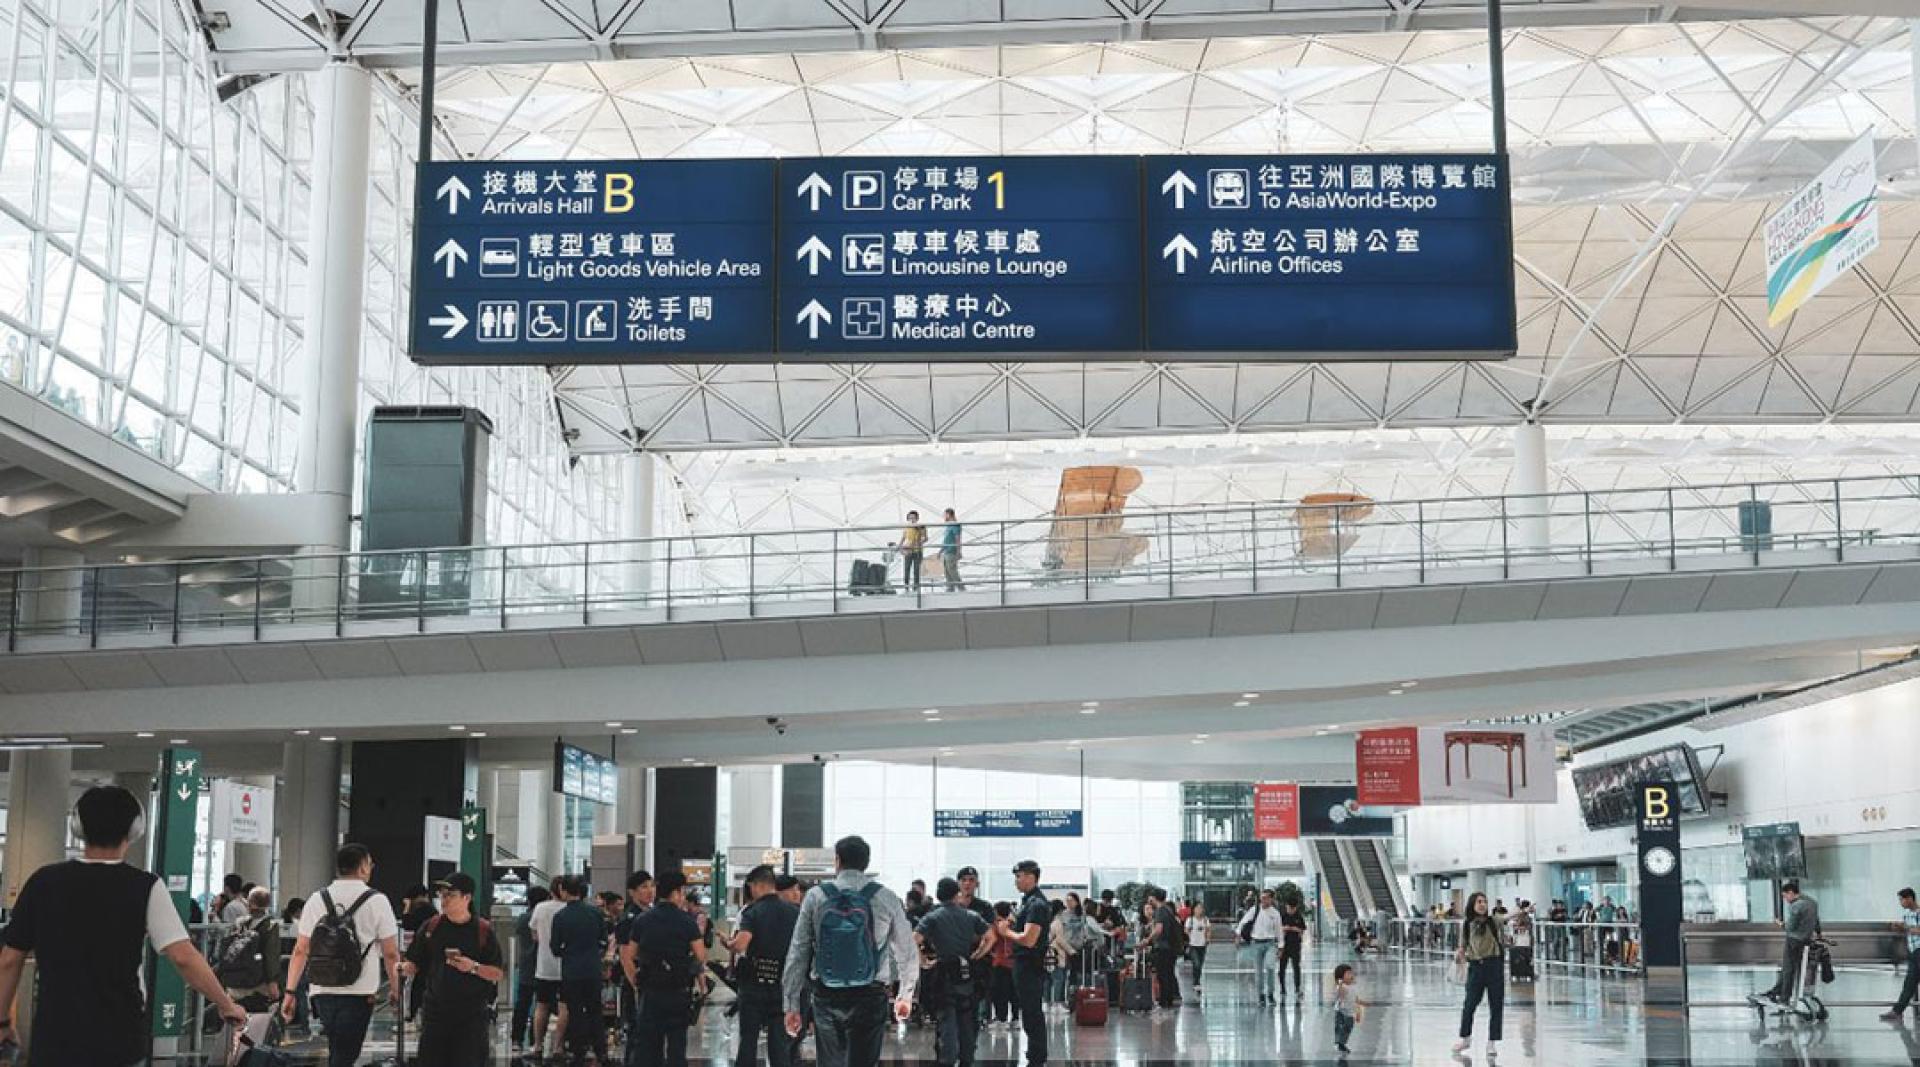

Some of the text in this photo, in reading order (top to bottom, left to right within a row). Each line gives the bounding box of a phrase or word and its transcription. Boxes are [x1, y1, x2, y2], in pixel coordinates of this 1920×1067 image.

[483, 170, 597, 195] 接機大堂
[894, 167, 978, 191] 停車場
[1259, 165, 1495, 189] 往亞洲國際博覽館
[604, 174, 634, 213] B
[892, 194, 971, 210] Car Park
[988, 172, 1003, 209] 1
[1259, 192, 1437, 211] To AsiaWorld-Expo
[482, 197, 592, 214] Arrivals Hall
[528, 233, 675, 257] 輕型貨車區
[893, 229, 1040, 255] 專車候車處
[1211, 228, 1419, 253] 航空公司辦公室
[528, 258, 760, 281] Light Goods Vehicle Area
[892, 258, 1067, 277] Limousine Lounge
[1210, 256, 1342, 273] Airline Offices
[628, 297, 711, 322] 洗手間
[893, 293, 1011, 318] 醫療中心
[626, 324, 685, 341] Toilets
[892, 321, 1035, 338] Medical Centre
[1645, 787, 1669, 818] B
